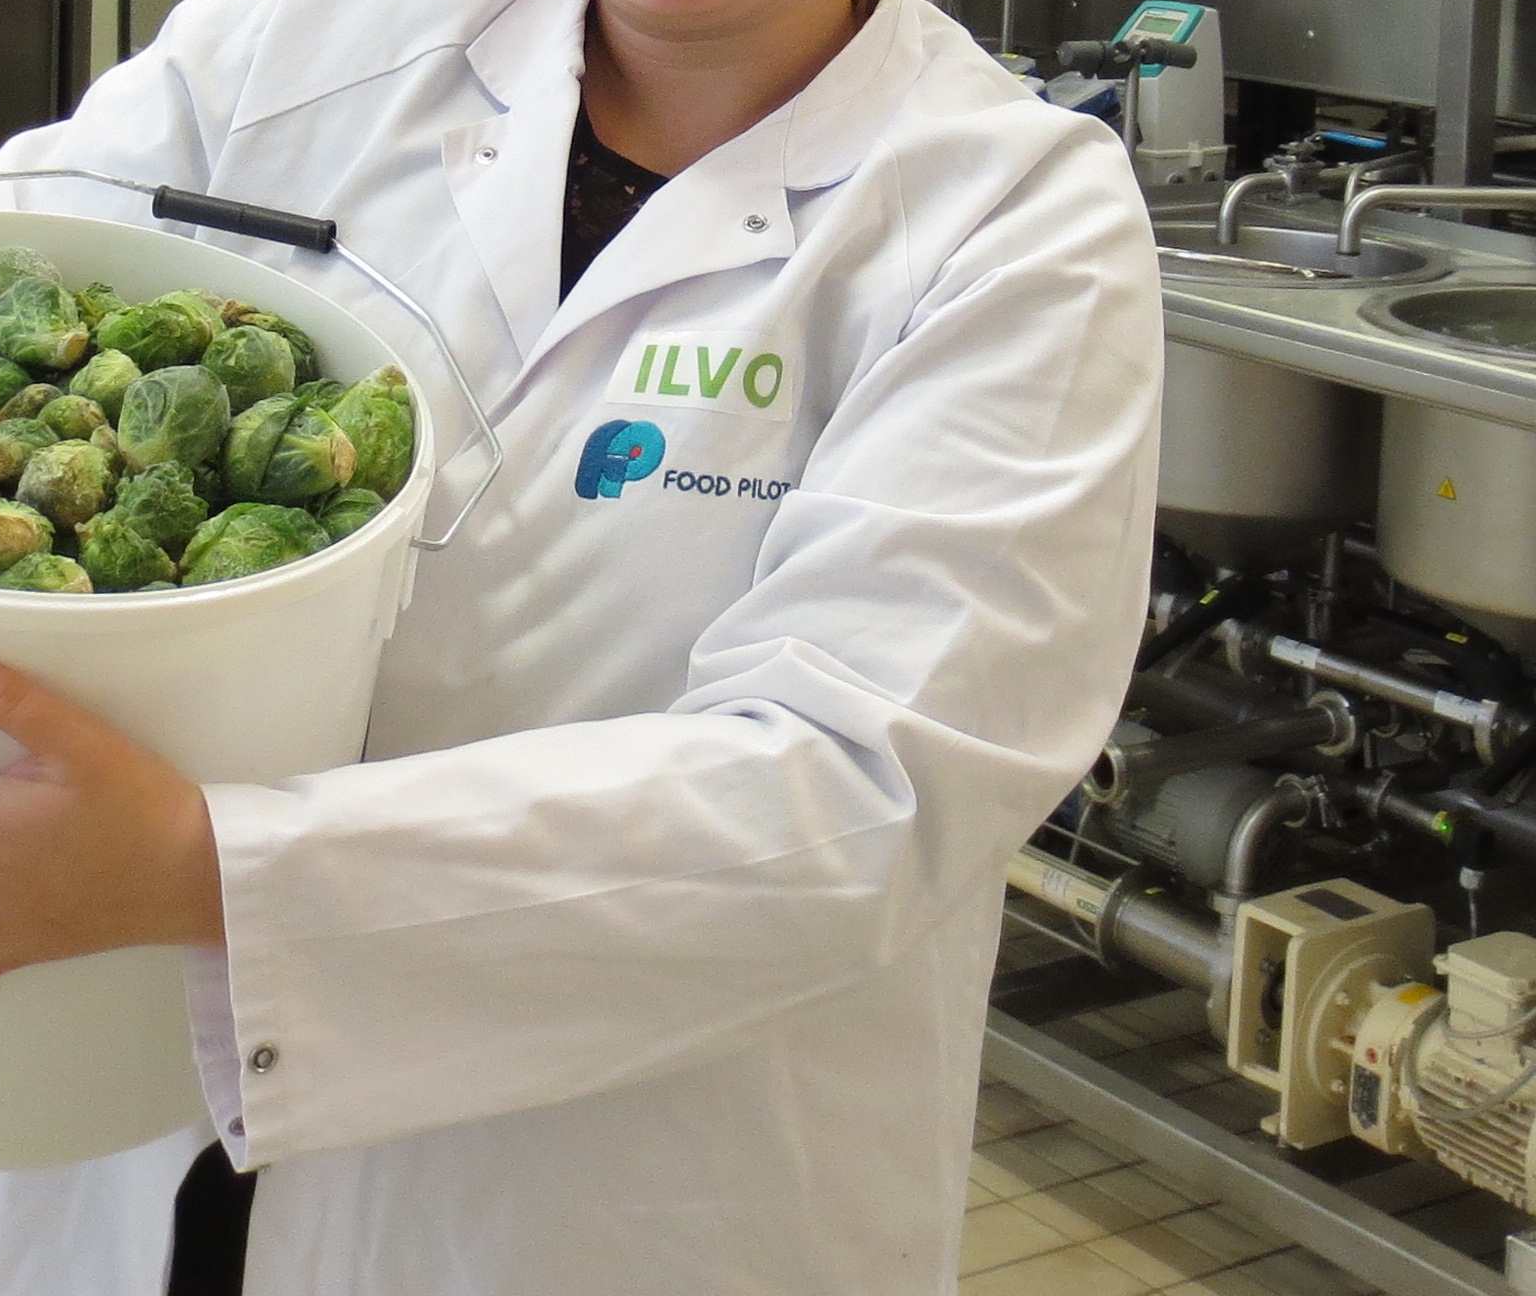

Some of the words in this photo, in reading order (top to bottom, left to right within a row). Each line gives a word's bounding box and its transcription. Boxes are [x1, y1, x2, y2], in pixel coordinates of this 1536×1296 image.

[634, 344, 783, 408] ILVO
[663, 469, 731, 497] FOOD
[737, 477, 791, 500] PILOT
